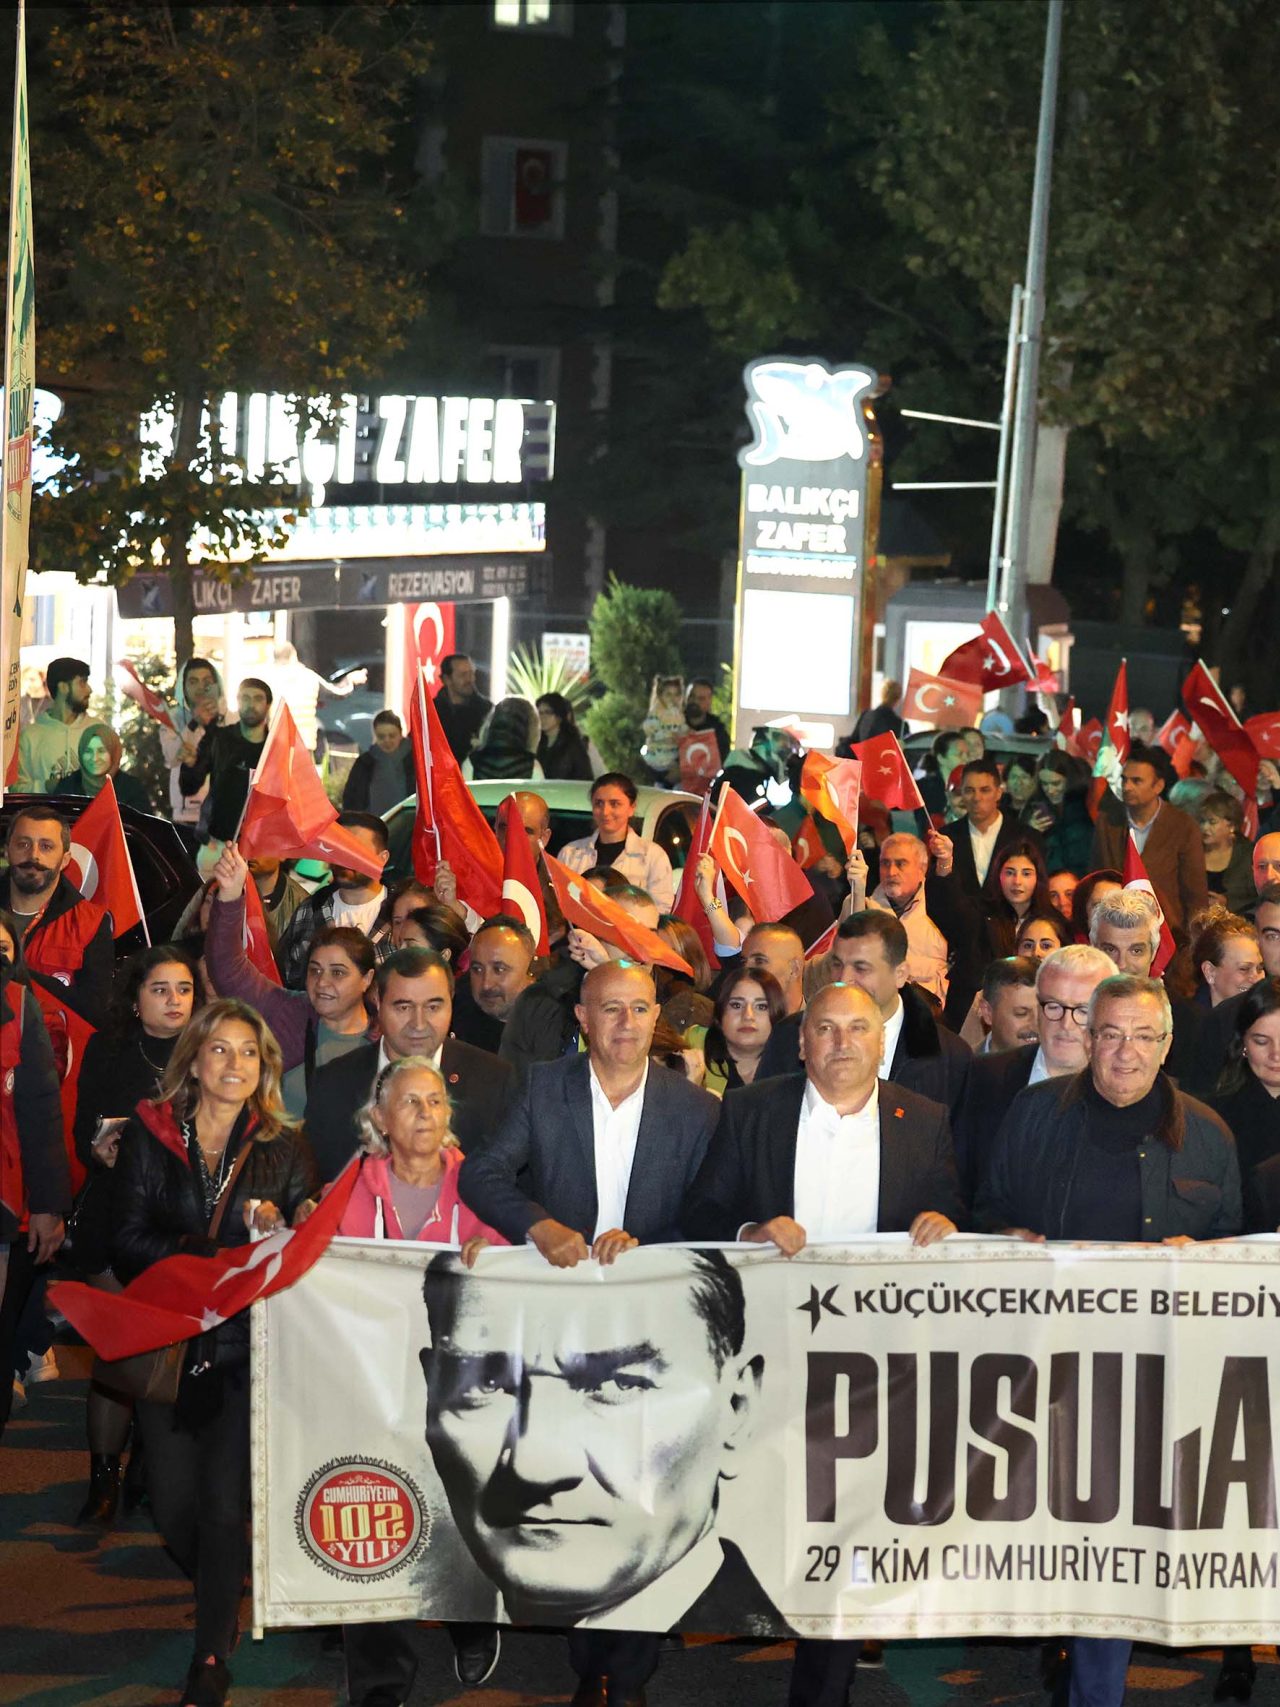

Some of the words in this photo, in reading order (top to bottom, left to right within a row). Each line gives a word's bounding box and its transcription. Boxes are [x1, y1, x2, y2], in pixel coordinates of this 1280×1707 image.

[377, 395, 524, 483] ZAFER
[748, 484, 859, 523] BALIKÇI
[756, 520, 846, 553] ZAFER
[251, 576, 301, 605] ZAFER
[388, 569, 475, 599] REZERVASYON
[854, 1281, 1139, 1318] KÜÇÜKÇEKMECE
[319, 1503, 406, 1542] 102
[335, 1540, 390, 1564] YILI
[805, 1545, 841, 1583] 29
[851, 1538, 930, 1583] EKİM
[941, 1536, 1146, 1585] CUMHURİYET
